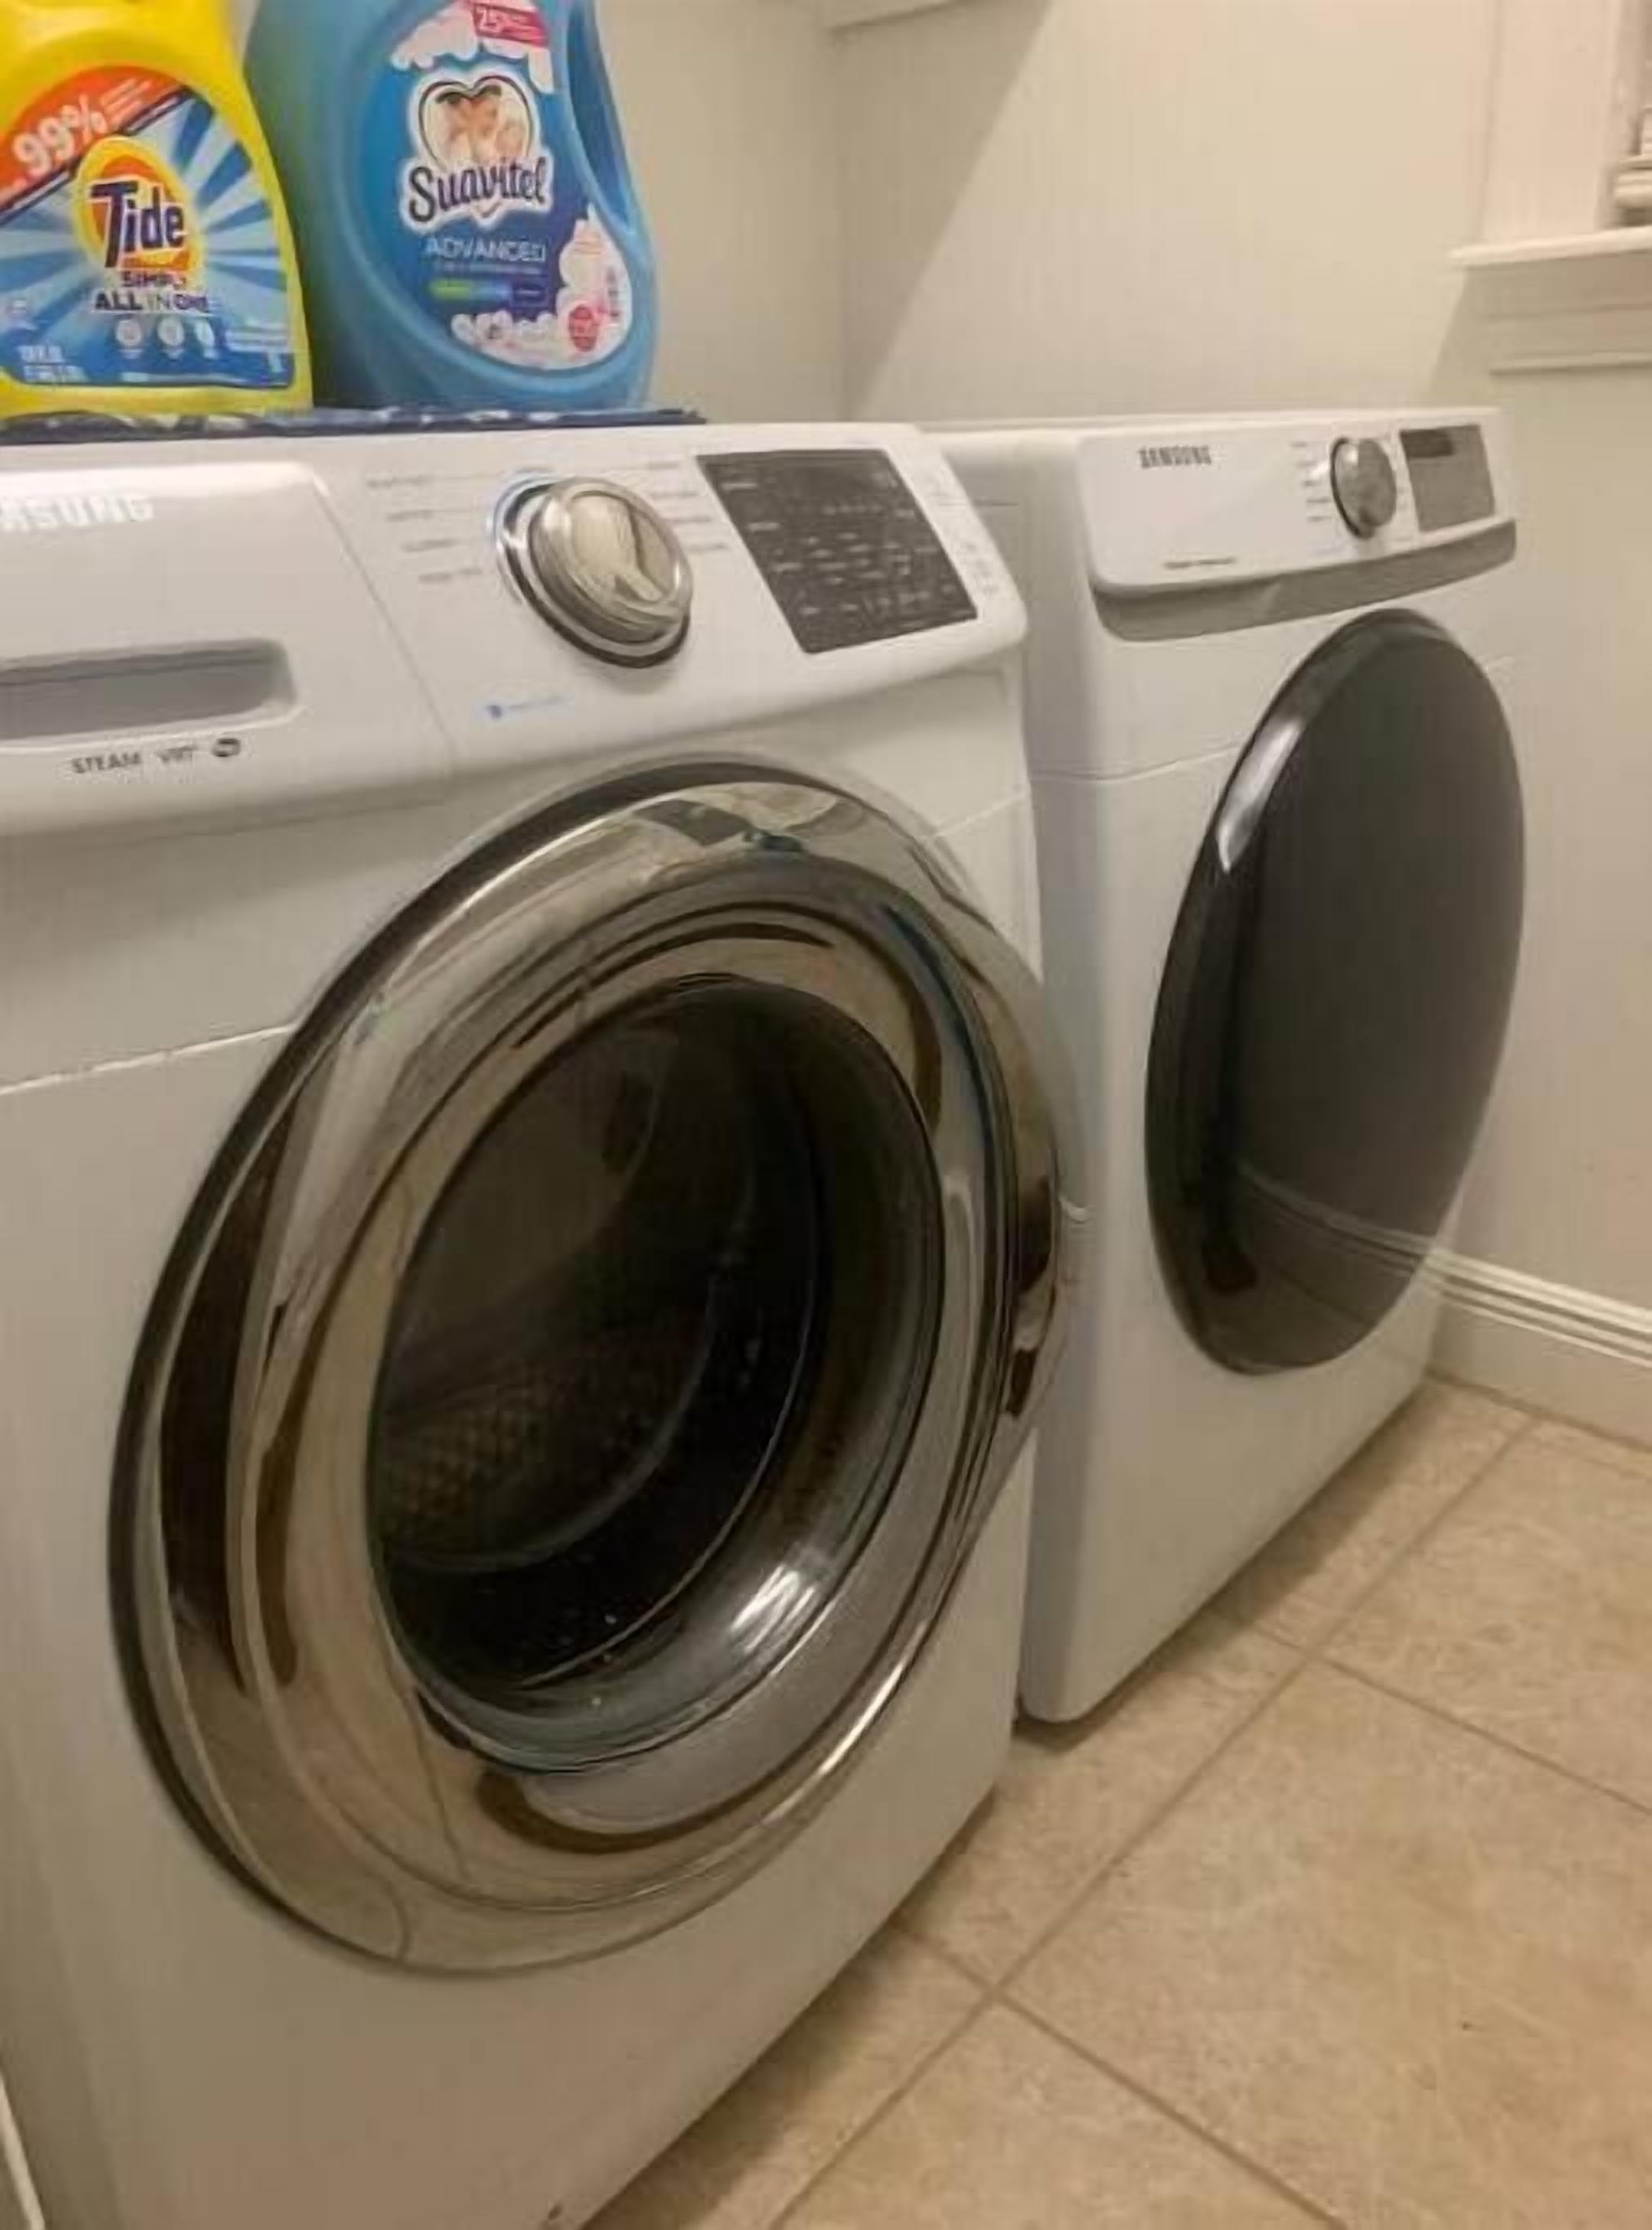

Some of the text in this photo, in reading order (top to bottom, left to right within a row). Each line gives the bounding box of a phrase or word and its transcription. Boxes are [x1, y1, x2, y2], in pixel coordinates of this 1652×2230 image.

[12, 93, 108, 178] 99%
[409, 158, 547, 222] Suavitel
[91, 180, 184, 269] Tide
[424, 236, 546, 262] ADVANCED
[95, 290, 143, 310] ALL
[1139, 445, 1212, 469] SAMSUNG
[71, 752, 143, 774] STEAM
